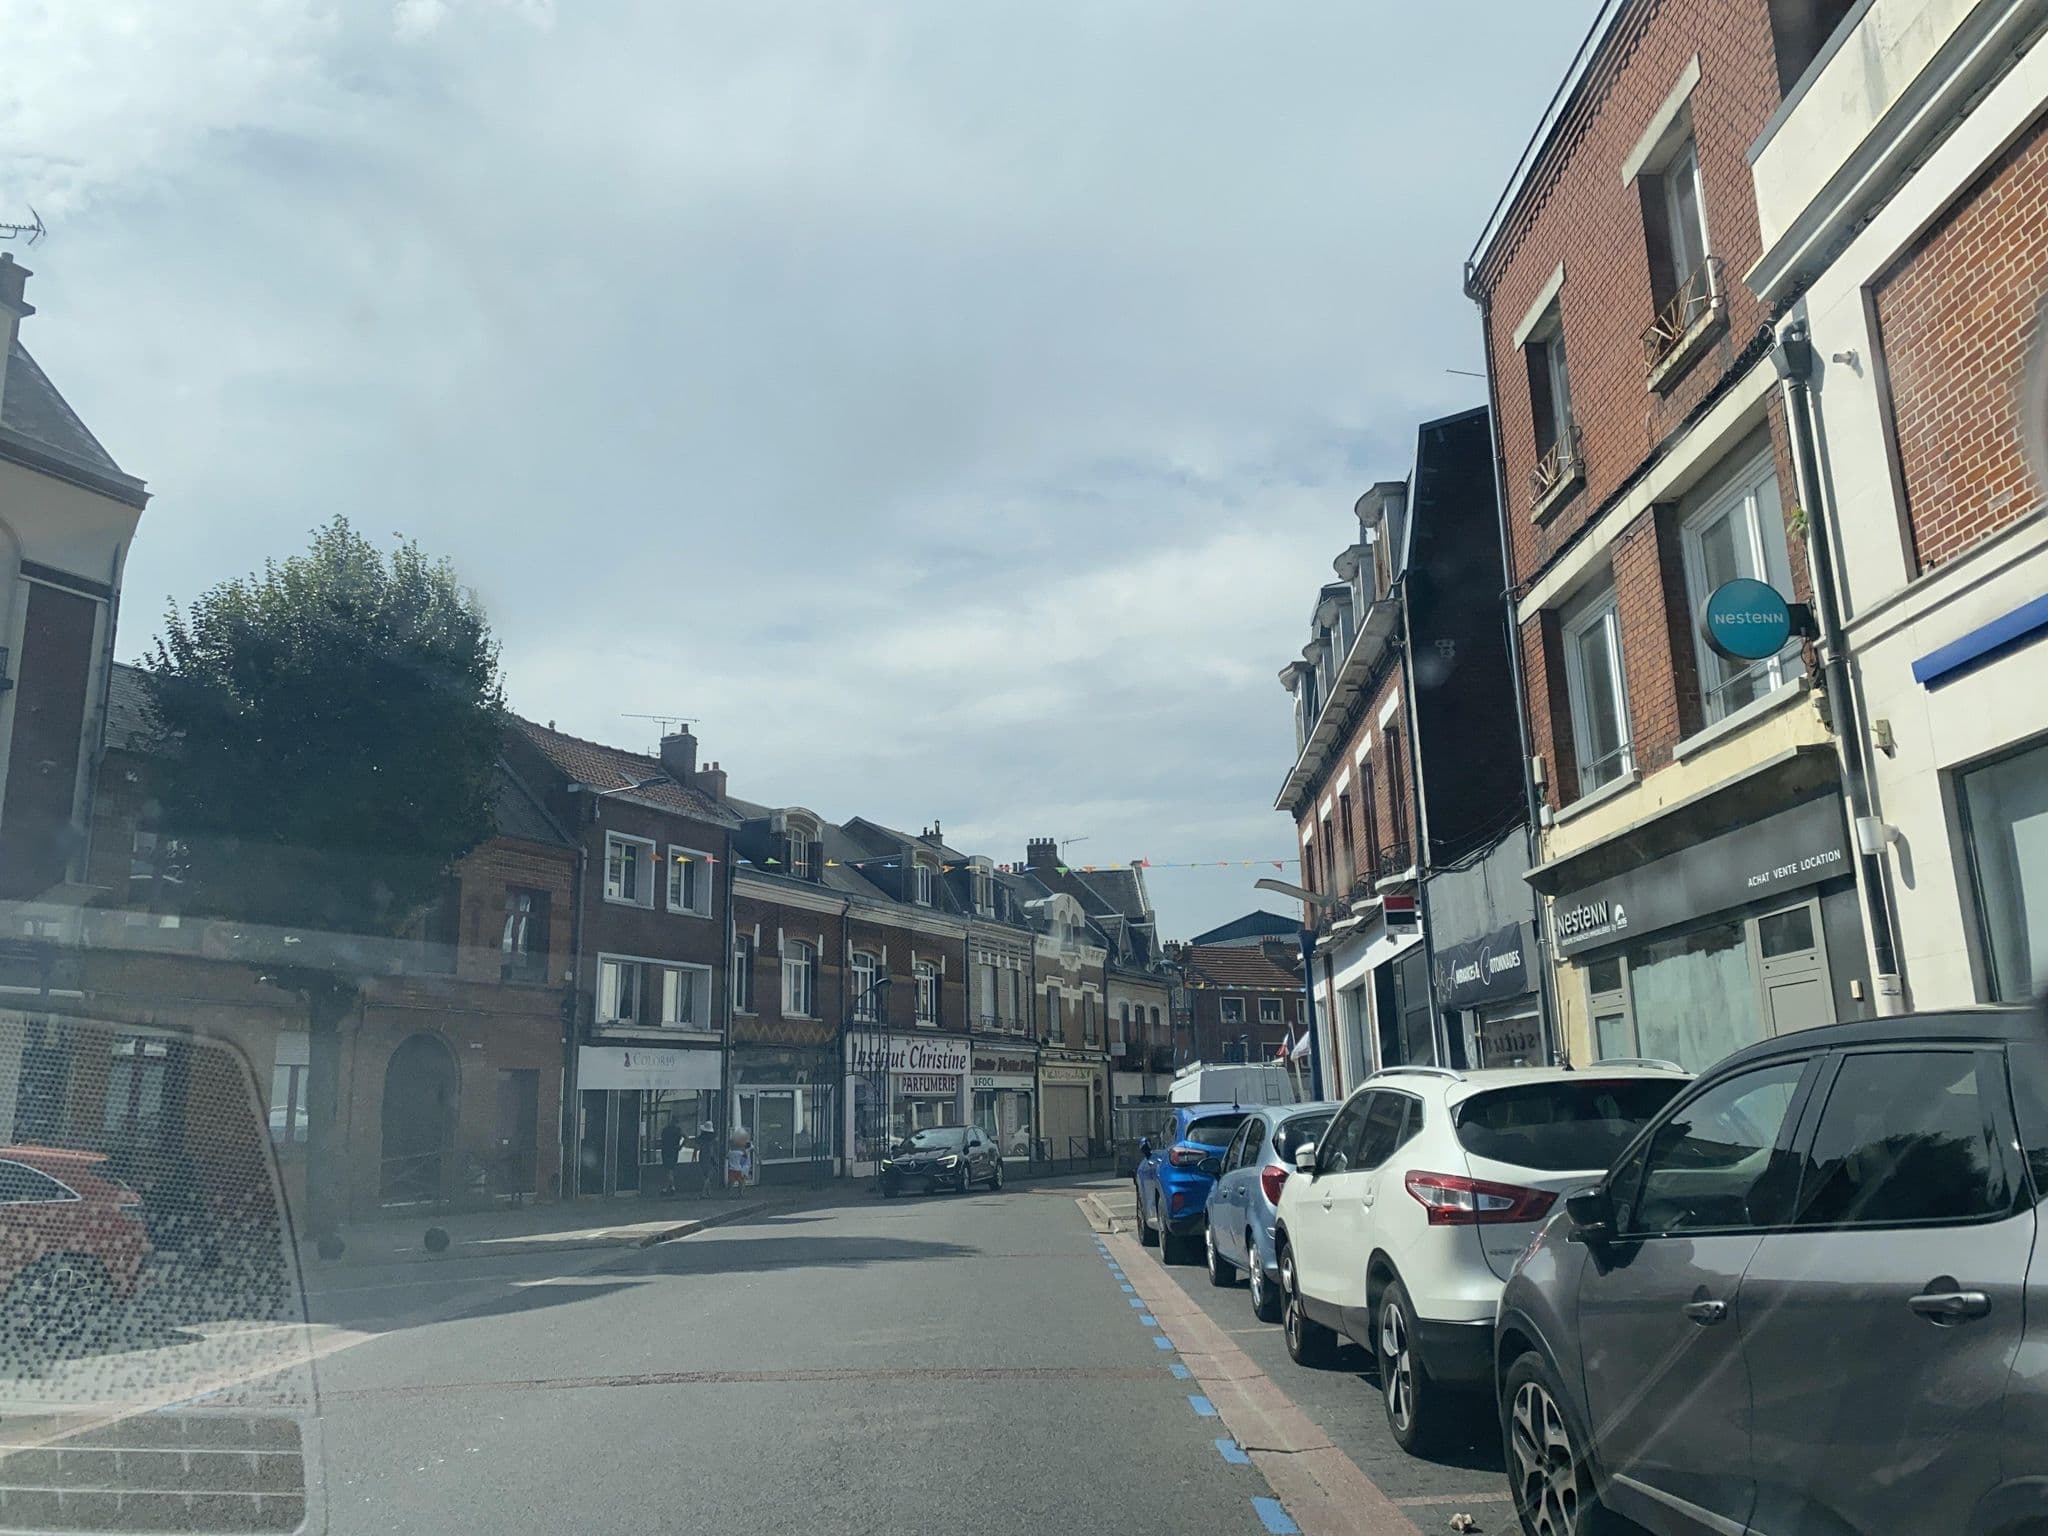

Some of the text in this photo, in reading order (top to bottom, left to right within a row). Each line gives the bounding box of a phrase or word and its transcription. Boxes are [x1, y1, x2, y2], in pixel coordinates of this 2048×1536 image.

[1748, 849, 1841, 887] ACHAT VENTE LOCATION
[851, 1042, 906, 1068] Institut
[909, 1045, 967, 1070] Christine
[903, 1076, 957, 1093] PARFUMERIE
